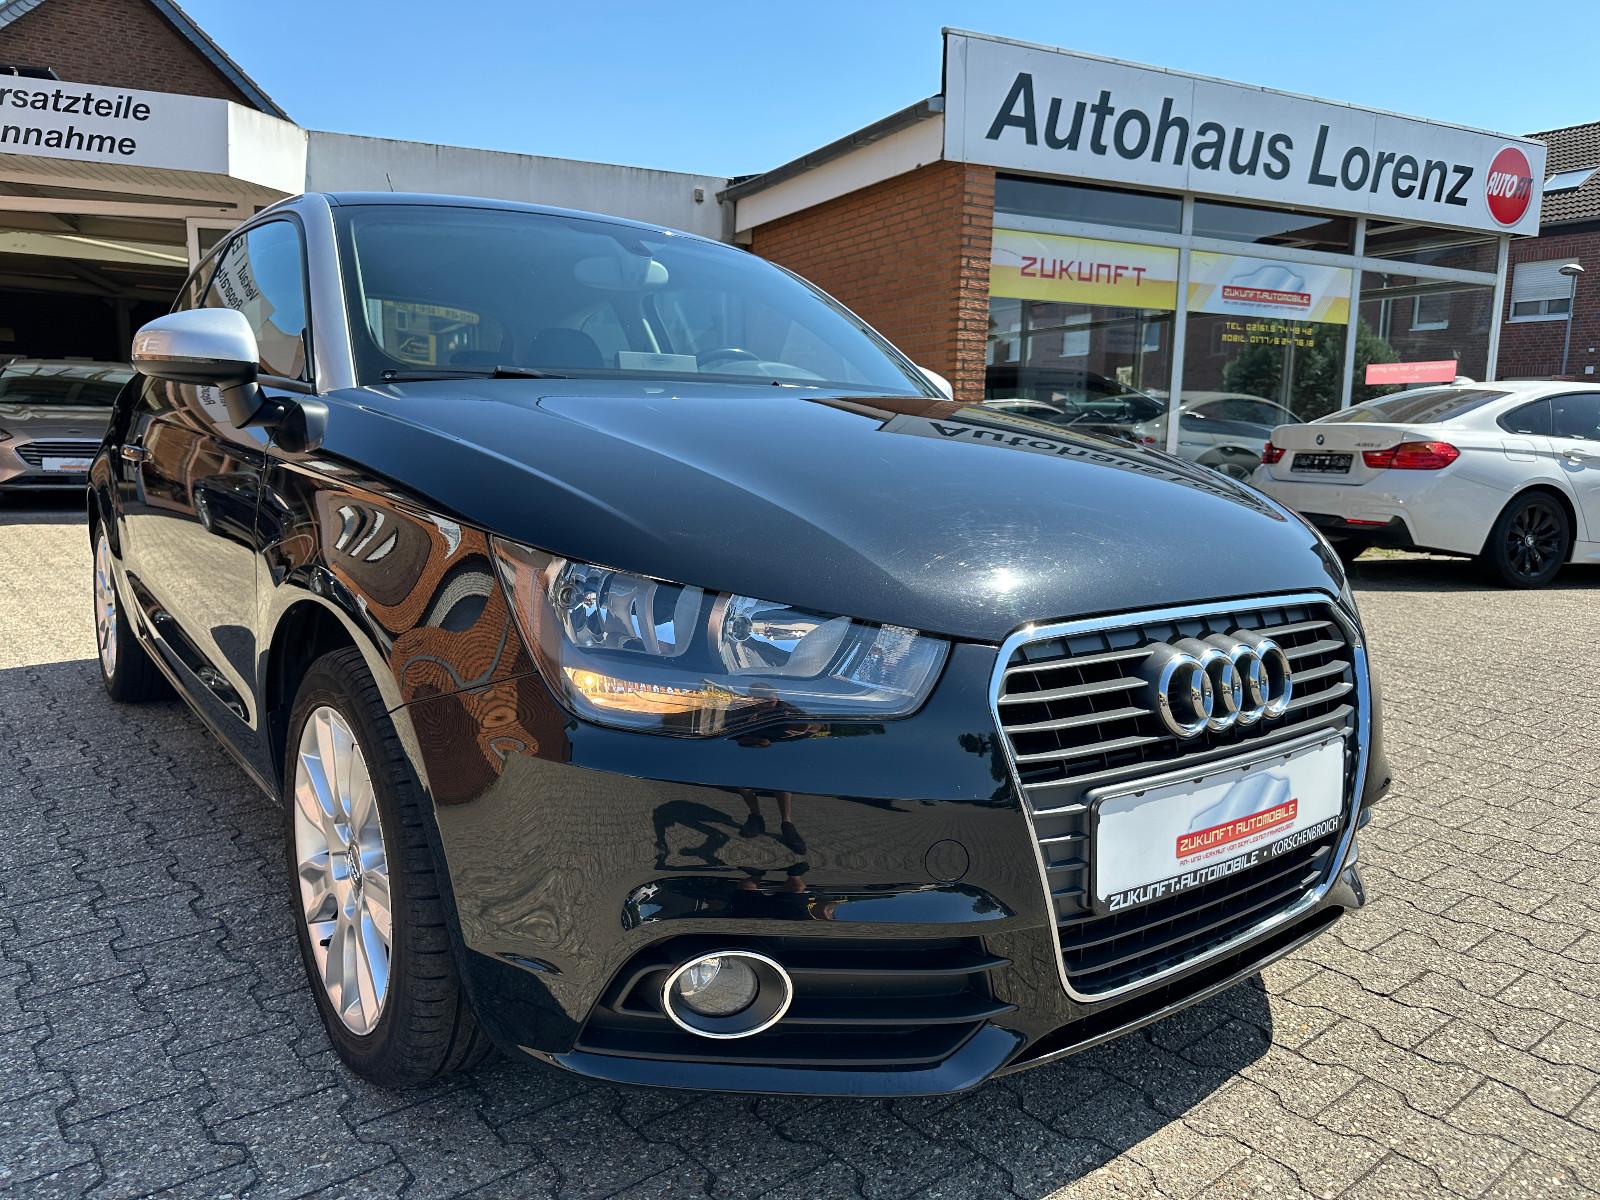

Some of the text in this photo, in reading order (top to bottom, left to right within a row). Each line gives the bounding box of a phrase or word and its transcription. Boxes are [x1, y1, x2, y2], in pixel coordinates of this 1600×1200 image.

[986, 72, 1474, 207] Autohaus Lorenz
[1020, 256, 1147, 287] ZUKUNFT
[1179, 802, 1297, 853] ZUKUNFT AUTOMOBILE
[1270, 816, 1340, 858] KORSCHENBROICH
